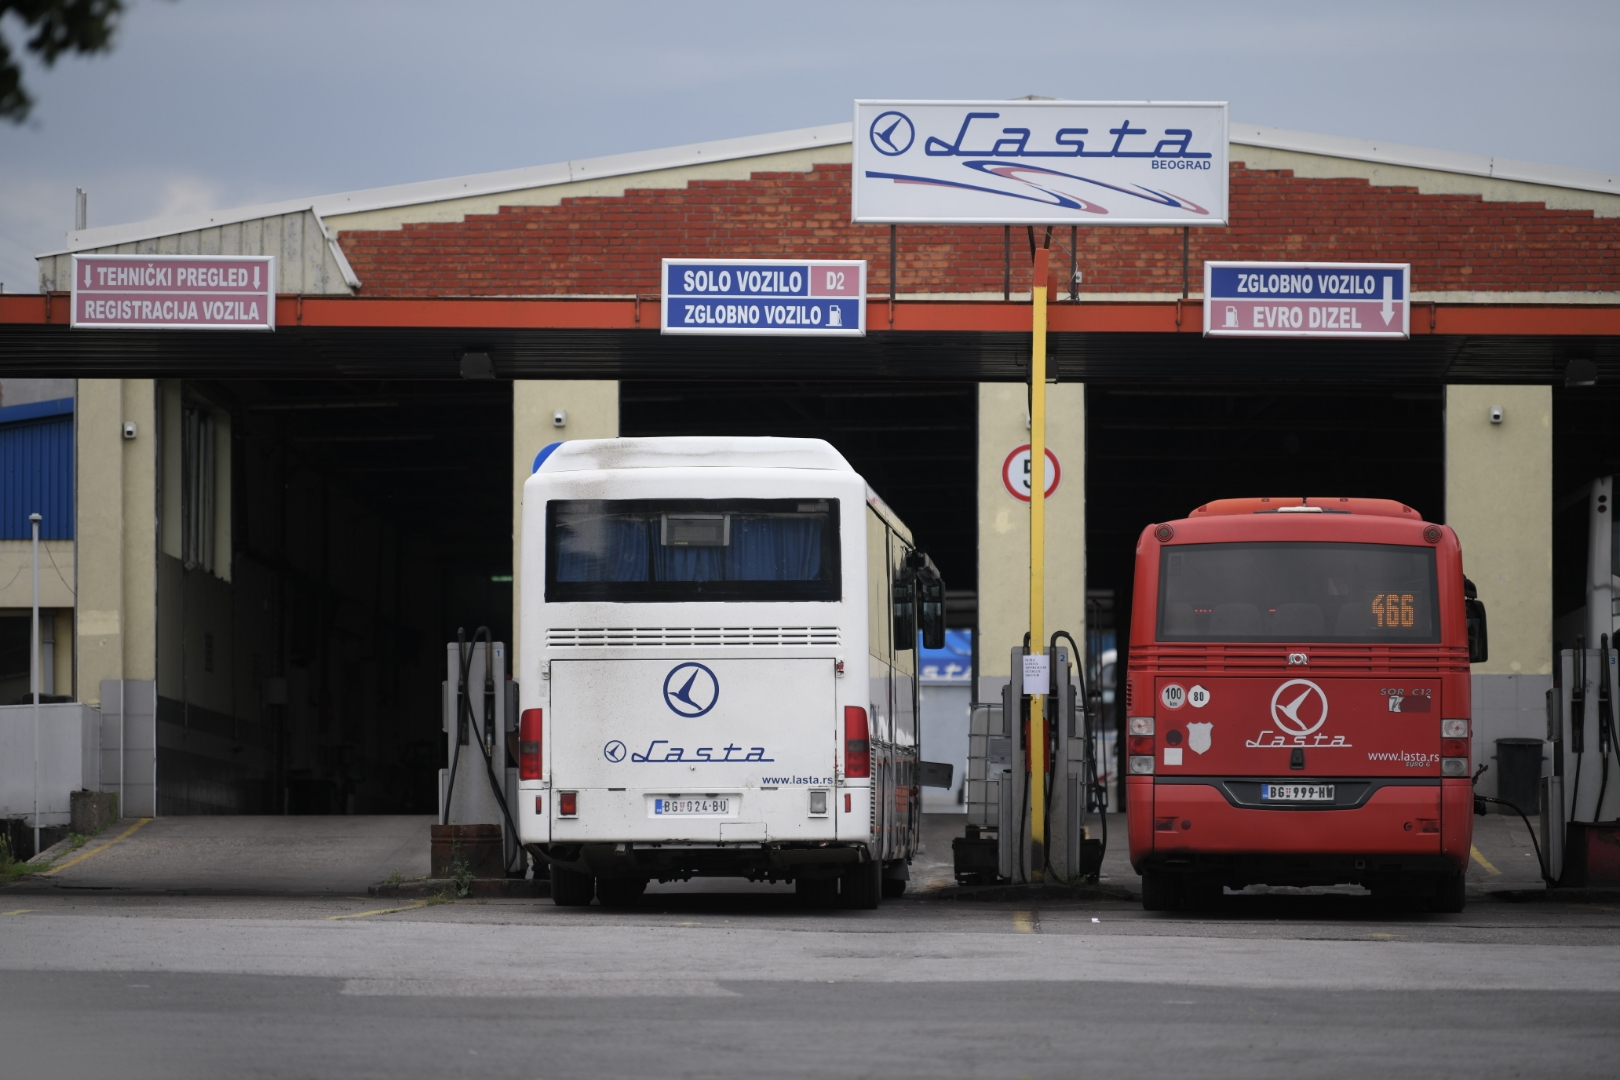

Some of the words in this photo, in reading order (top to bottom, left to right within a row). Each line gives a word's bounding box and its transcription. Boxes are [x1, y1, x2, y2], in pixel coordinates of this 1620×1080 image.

[925, 112, 1212, 157] Lasta
[1151, 160, 1211, 170] BEOGRAD
[97, 263, 171, 286] TEHNIČKI
[177, 268, 248, 286] PREGLED
[683, 270, 731, 292] SOLO
[736, 271, 802, 292] VOZILO
[826, 271, 844, 290] D2
[1237, 274, 1313, 293] ZGLOBNO
[1318, 275, 1375, 294] VOZILO
[85, 300, 198, 319] REGISTRACIJA
[202, 302, 259, 320] VOZILA
[684, 305, 759, 324] ZGLOBNO
[764, 306, 821, 325] VOZILO
[1253, 306, 1302, 328] EVRO
[1309, 307, 1361, 328] DIZEL
[1372, 594, 1413, 627] 466
[1610, 657, 1616, 665] 3
[1165, 688, 1181, 700] 100
[1193, 691, 1204, 702] 80
[1380, 688, 1404, 696] SOR
[1245, 730, 1353, 748] Lasta
[631, 740, 775, 763] Lasta
[1368, 751, 1440, 762] www.lasta.rs
[762, 775, 833, 785] www.lasta.rs
[1270, 787, 1284, 798] BG
[664, 801, 678, 812] BG
